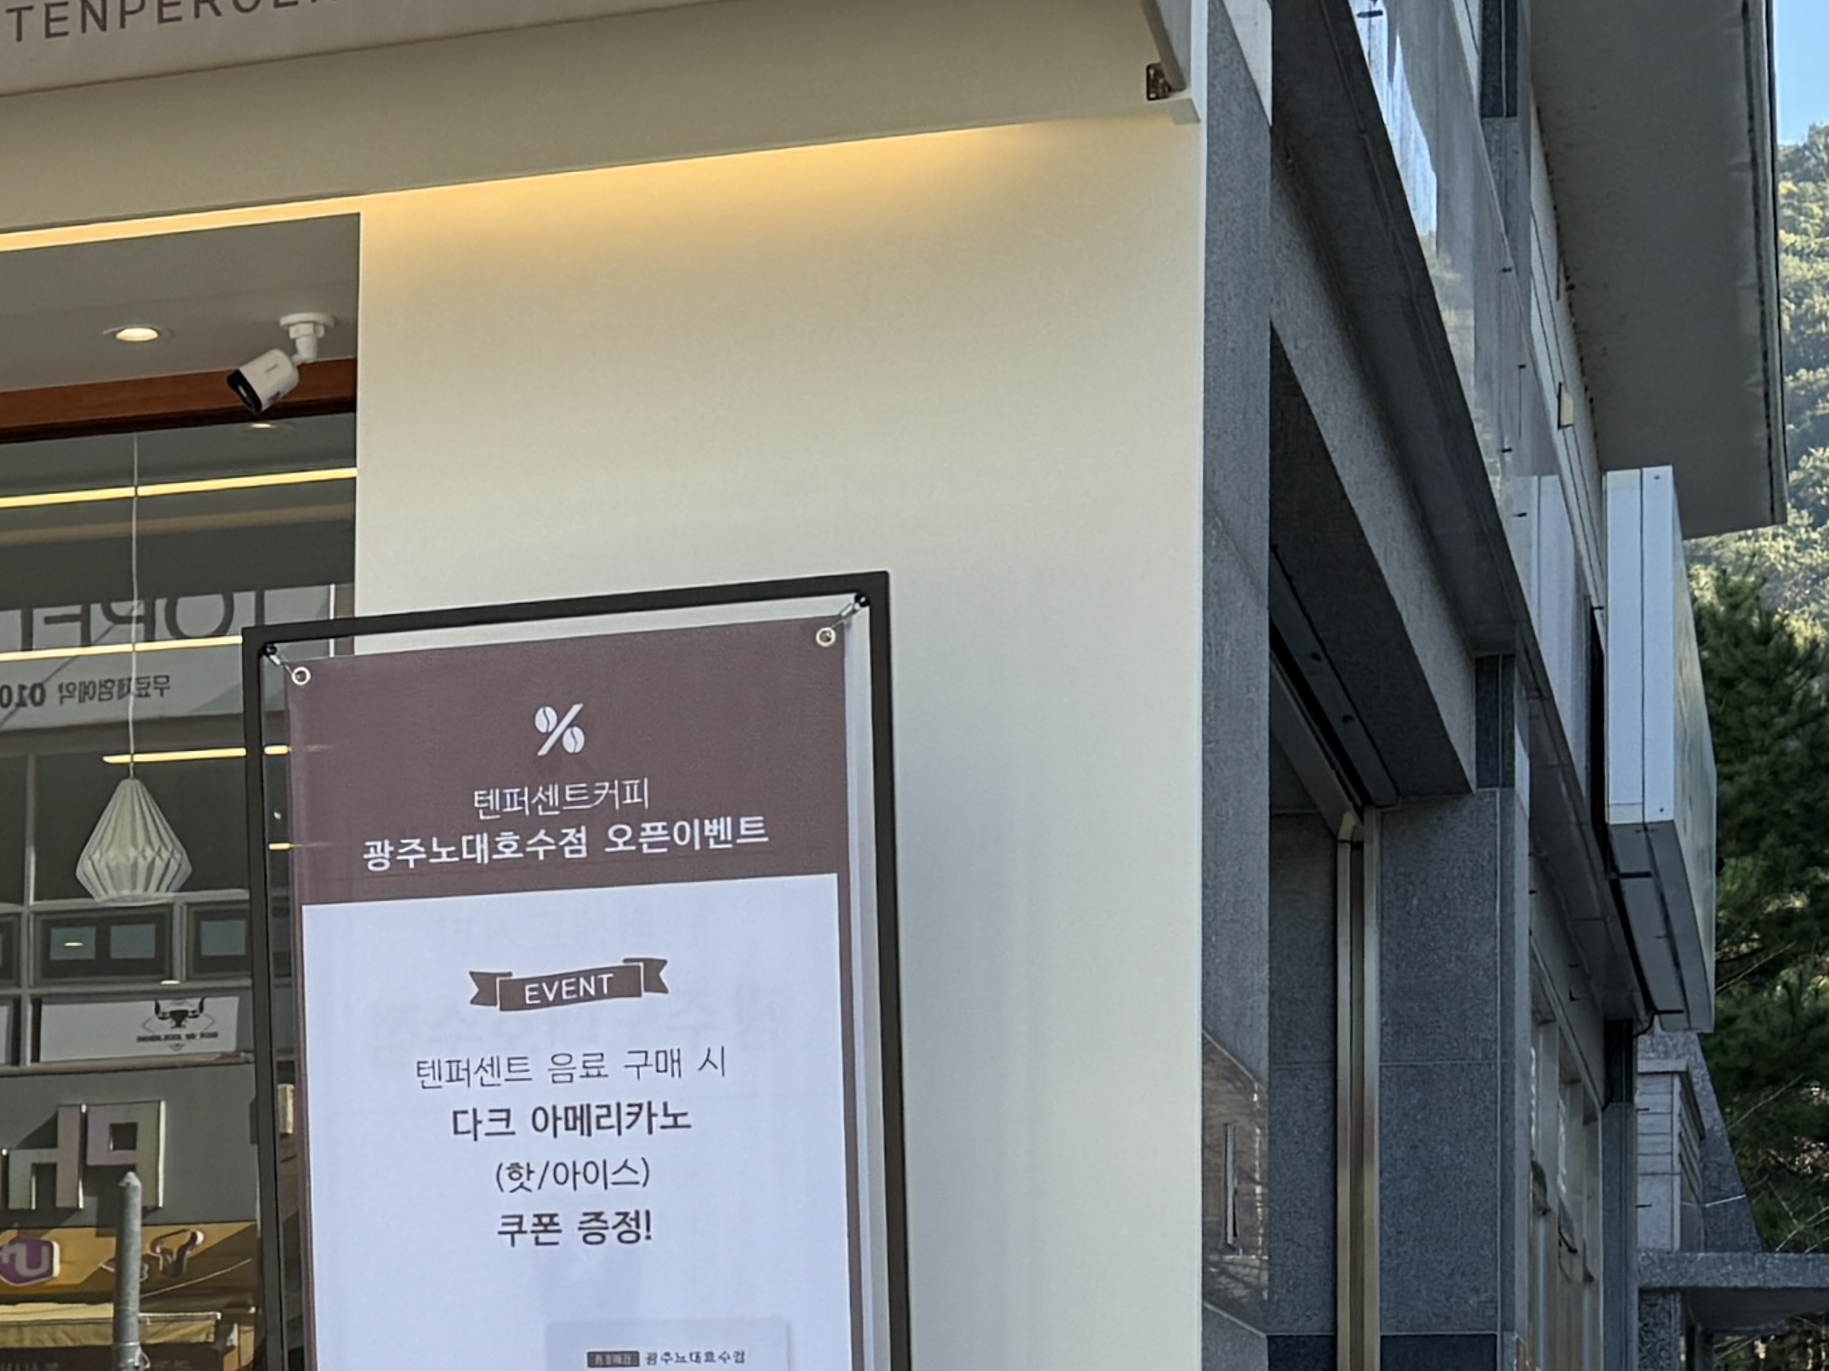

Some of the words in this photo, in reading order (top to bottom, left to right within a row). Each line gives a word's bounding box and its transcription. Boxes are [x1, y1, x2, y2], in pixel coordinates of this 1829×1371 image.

[473, 777, 650, 820] 텐퍼센트커피
[362, 826, 588, 872] 광주노대호수점
[603, 814, 769, 856] 오픈이벤트
[524, 972, 614, 1006] EVENT
[415, 1052, 533, 1091] 텐퍼센트
[547, 1051, 609, 1082] 음료
[623, 1046, 683, 1080] 구매
[698, 1044, 727, 1078] 시
[451, 1105, 517, 1142] 다크
[530, 1100, 693, 1139] 아메리카노
[494, 1156, 650, 1194] (핫/아이스)
[496, 1212, 564, 1249] 쿠폰
[577, 1208, 654, 1246] 증정!
